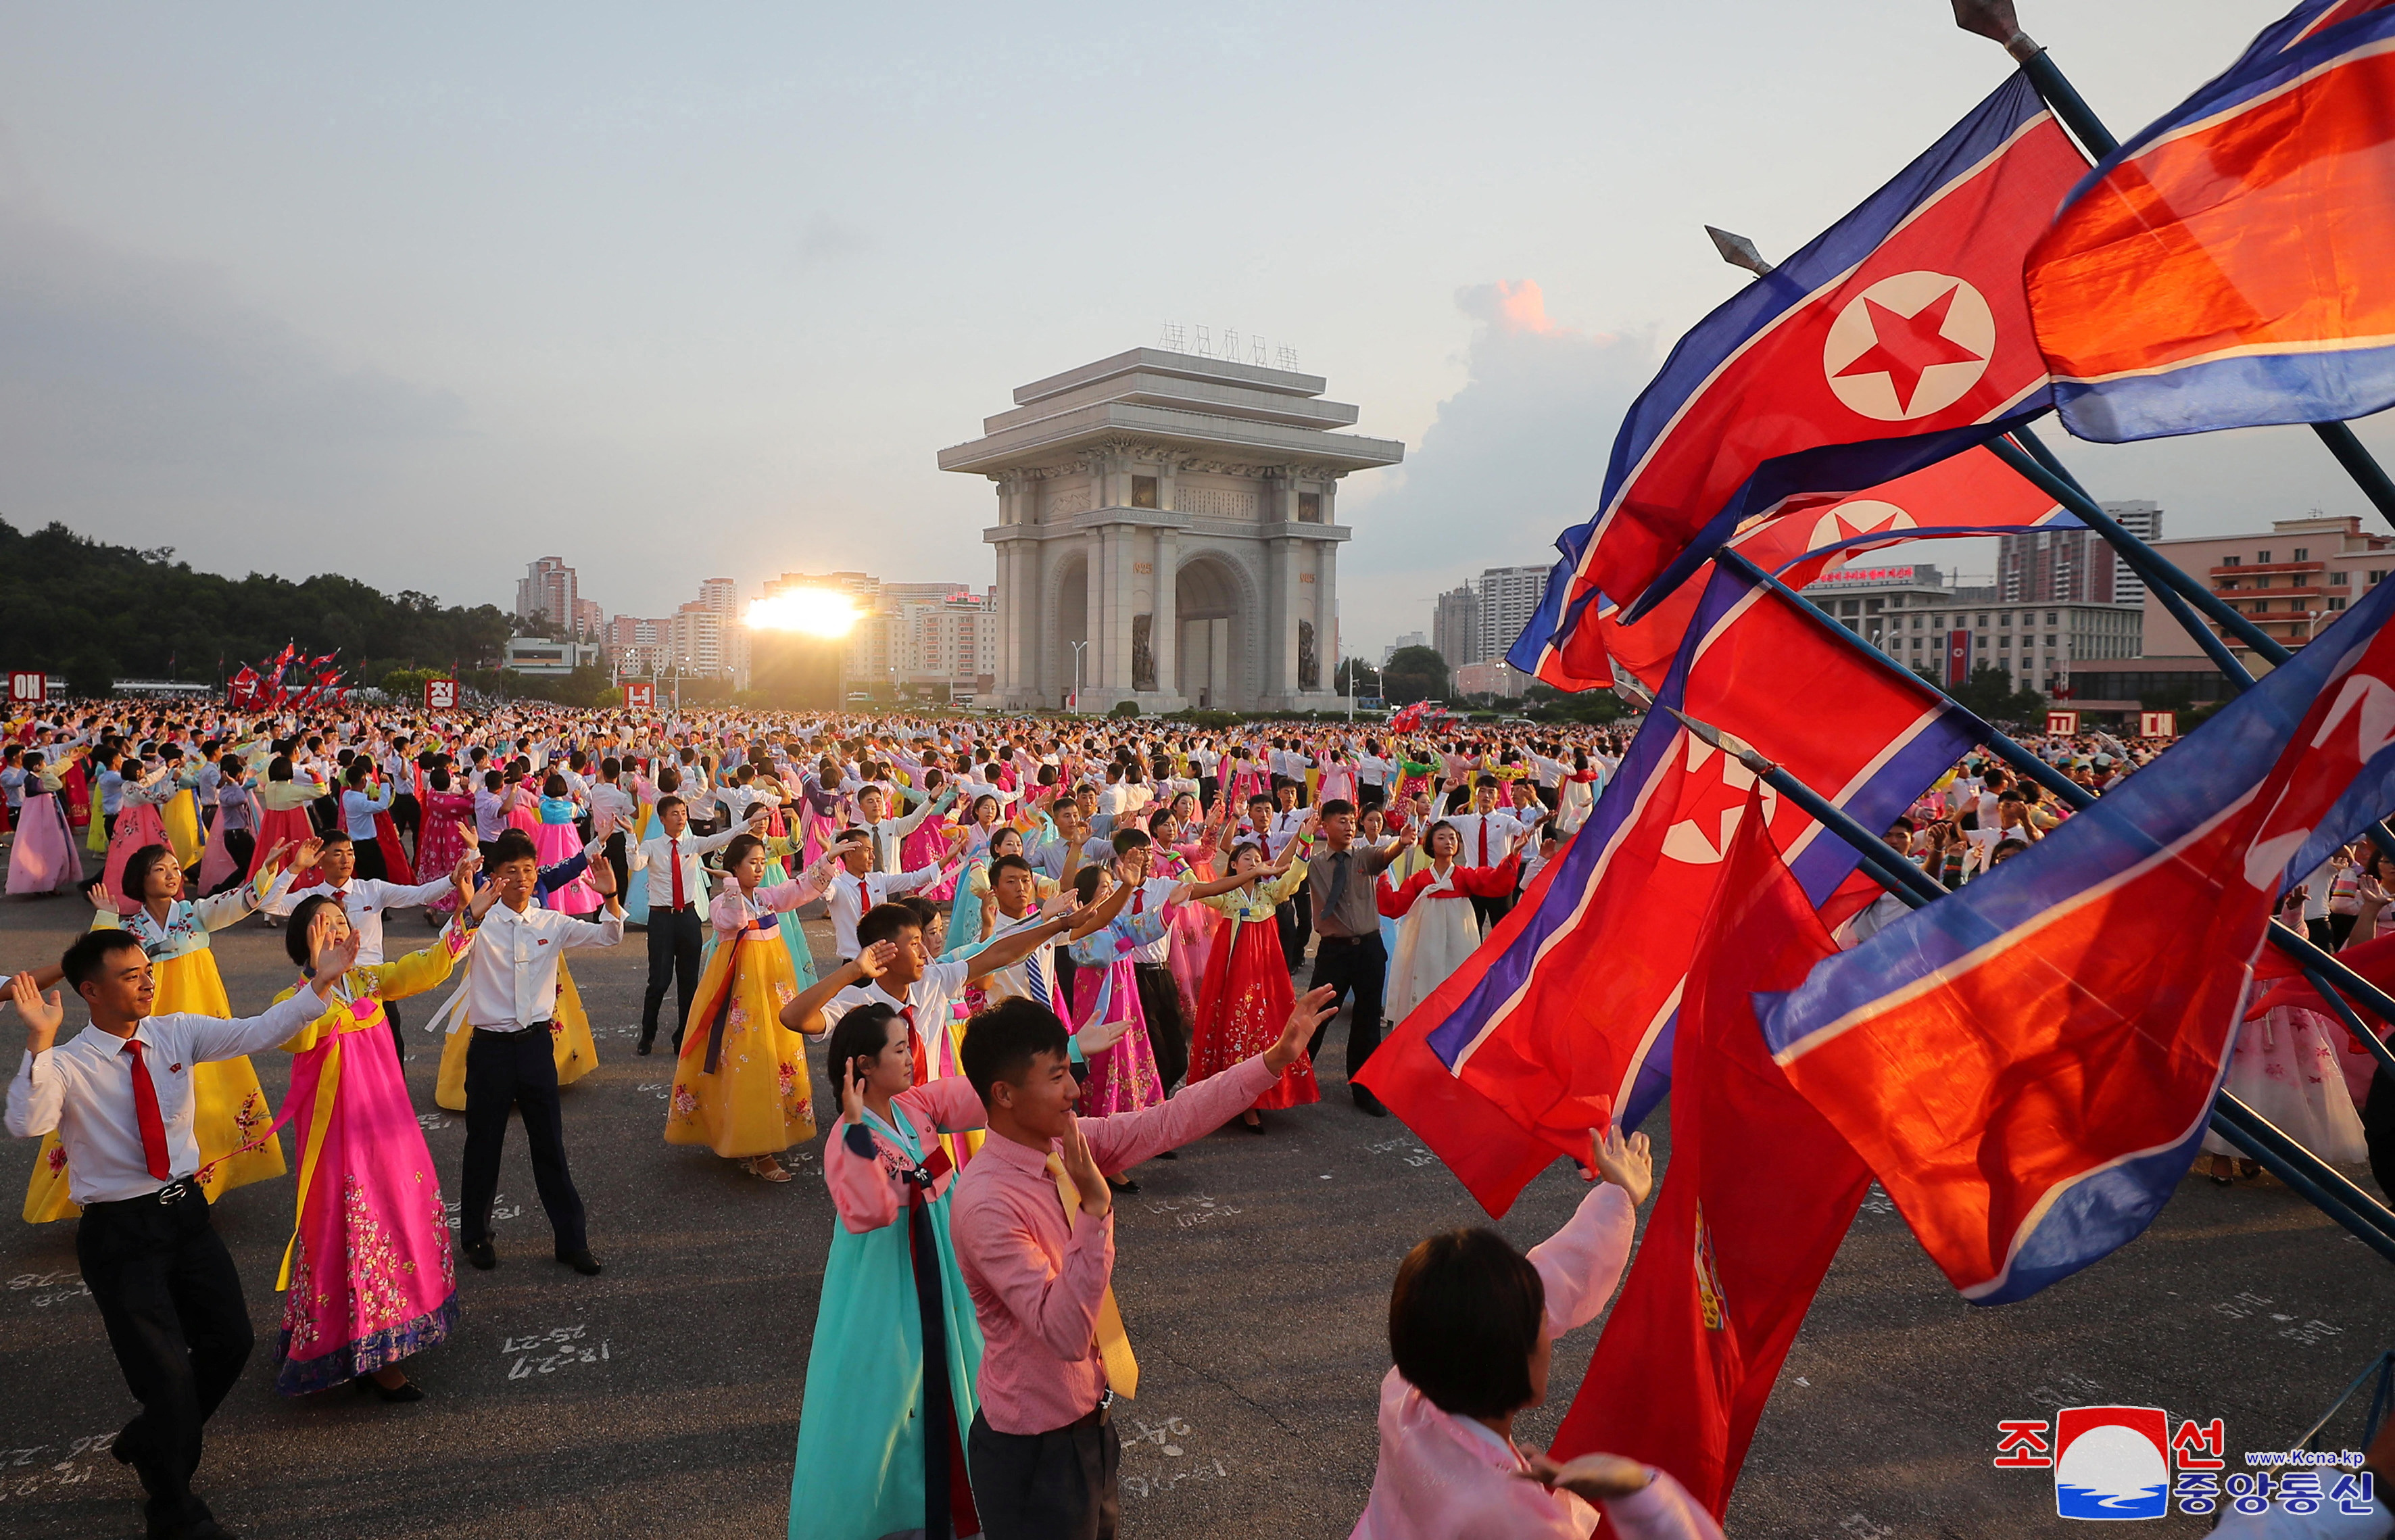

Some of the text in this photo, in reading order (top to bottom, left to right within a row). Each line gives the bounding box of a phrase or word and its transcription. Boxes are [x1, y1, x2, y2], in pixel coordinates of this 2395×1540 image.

[14, 674, 39, 699] 애
[431, 682, 454, 708] 청
[2142, 713, 2173, 737] 대
